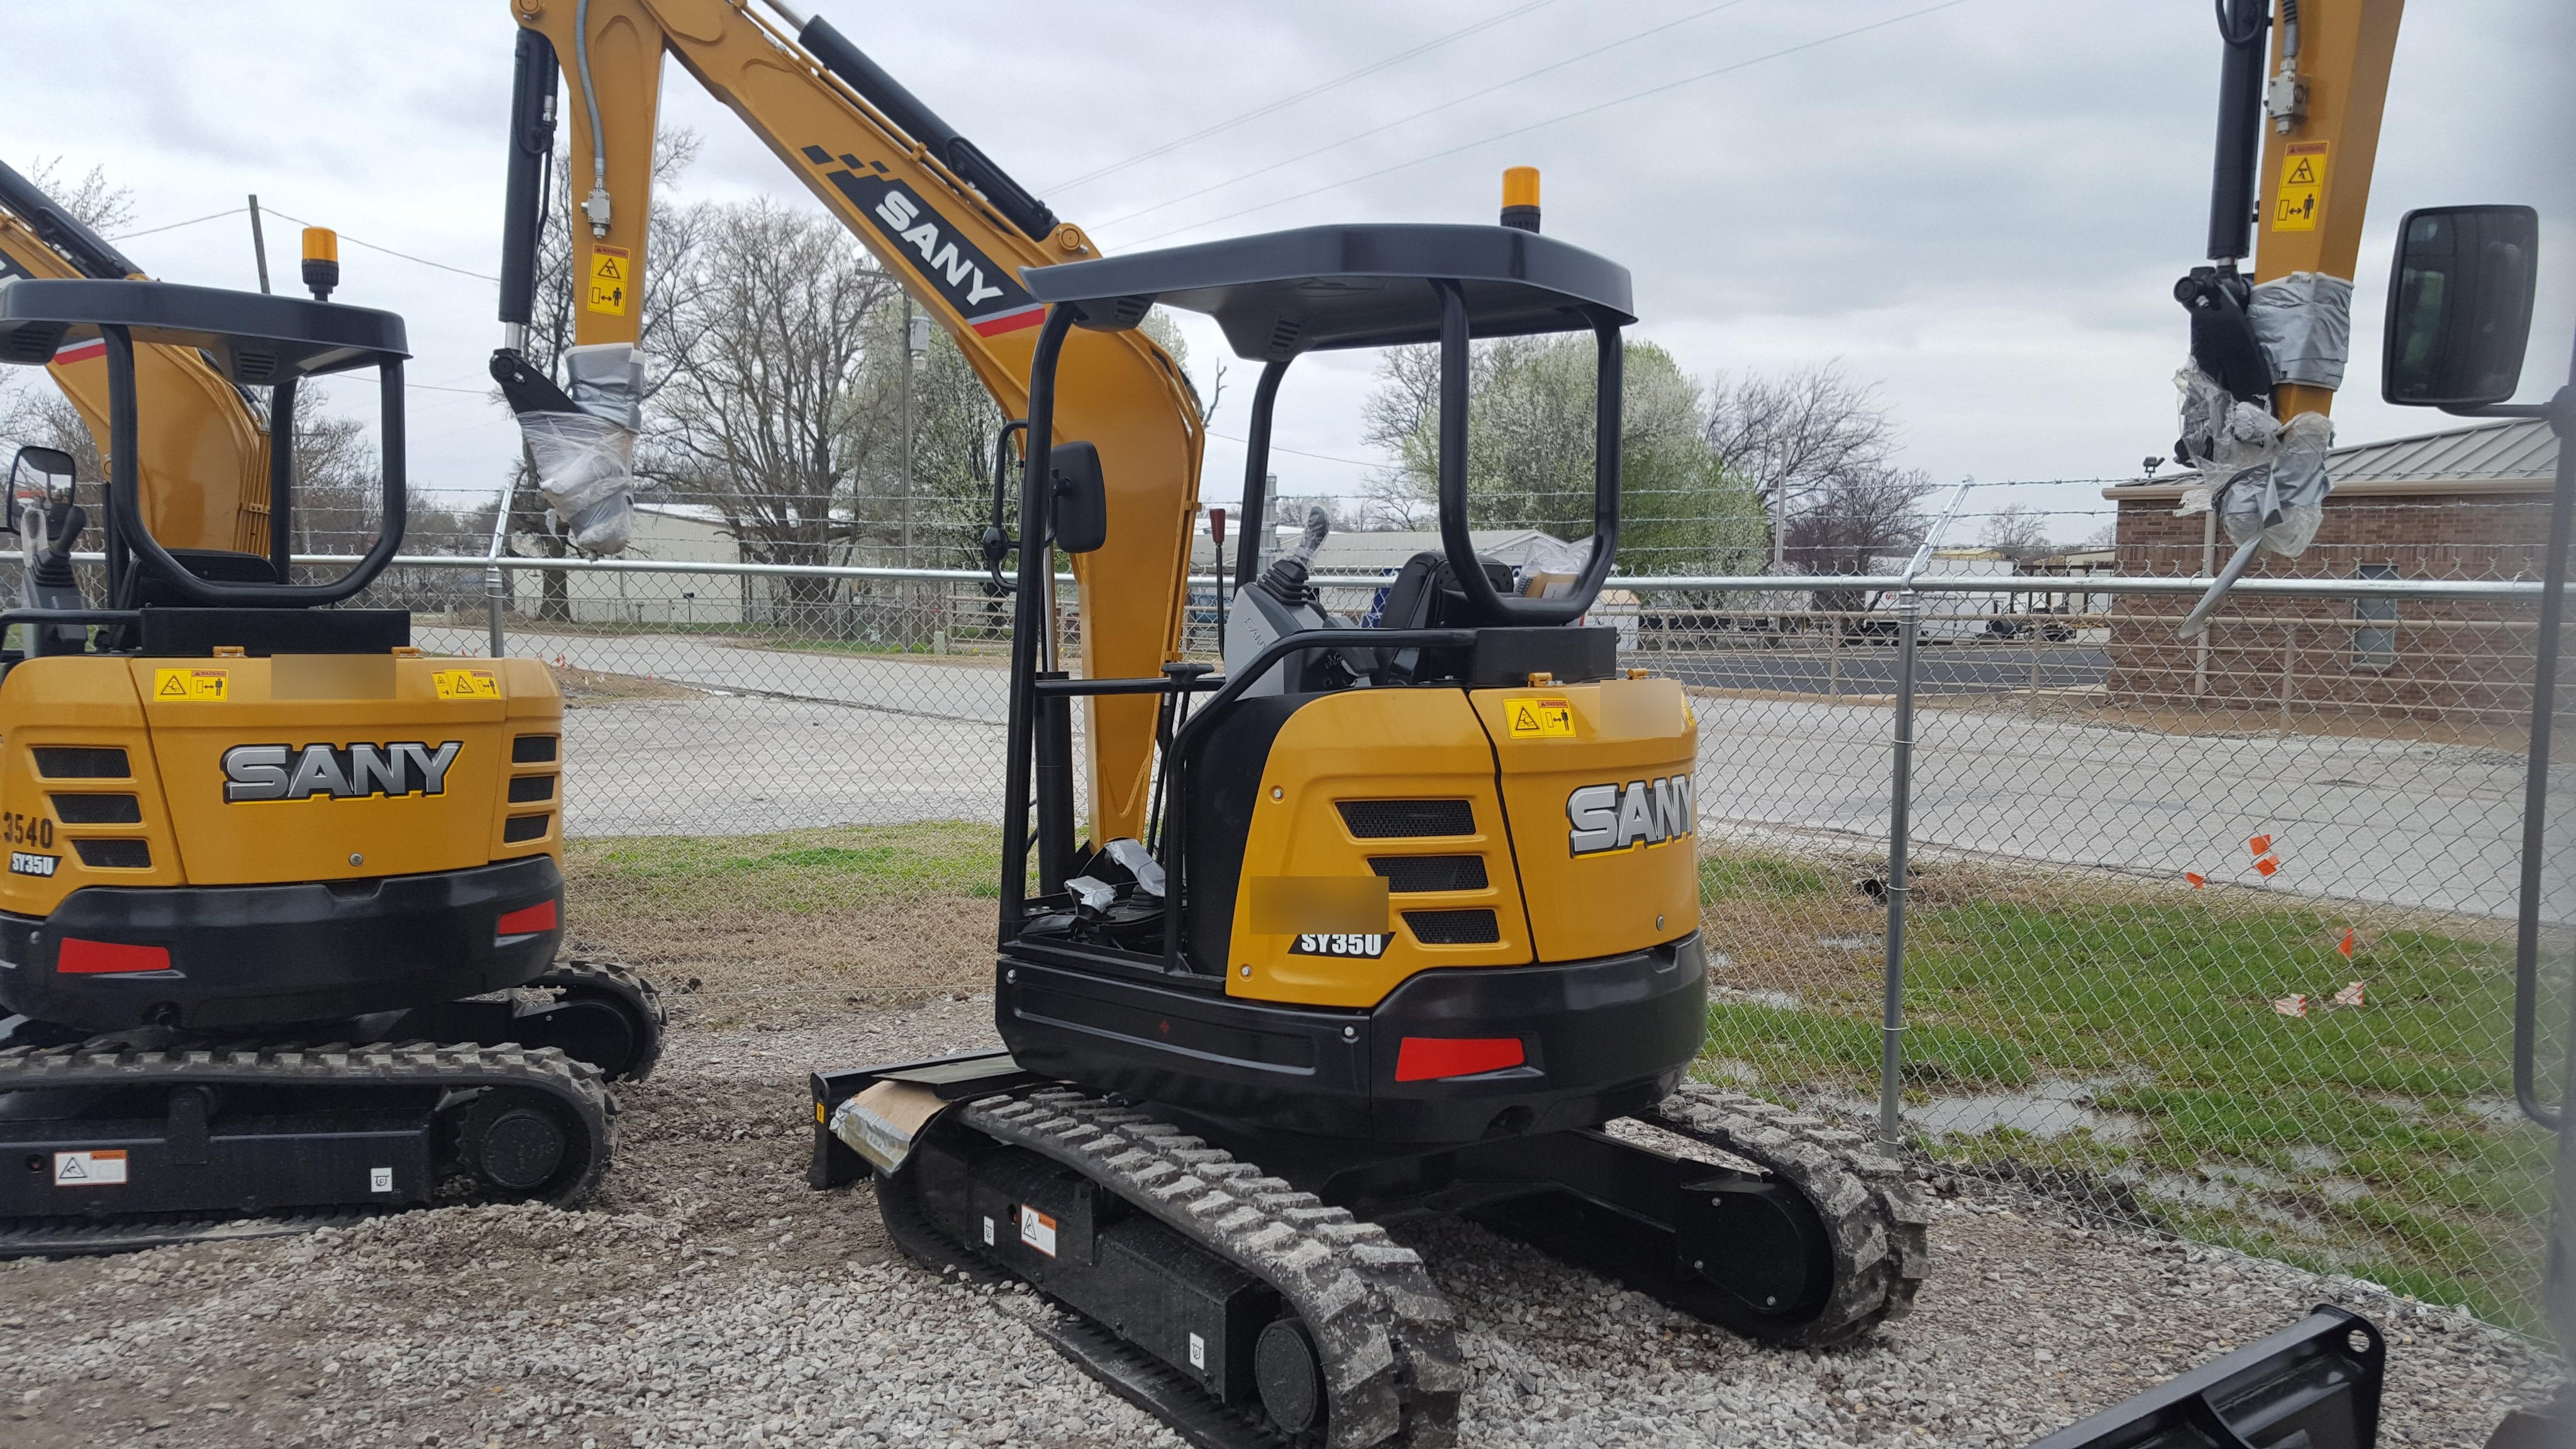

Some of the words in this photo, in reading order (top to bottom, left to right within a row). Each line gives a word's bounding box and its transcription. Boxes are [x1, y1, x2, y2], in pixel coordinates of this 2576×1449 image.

[875, 190, 1004, 306] SANY
[1245, 618, 1266, 649] SAN
[221, 742, 464, 802] SANY
[4, 811, 53, 849] 3540
[1567, 772, 1694, 853] SANY
[12, 852, 55, 875] SY35U
[1301, 934, 1382, 956] SY35U
